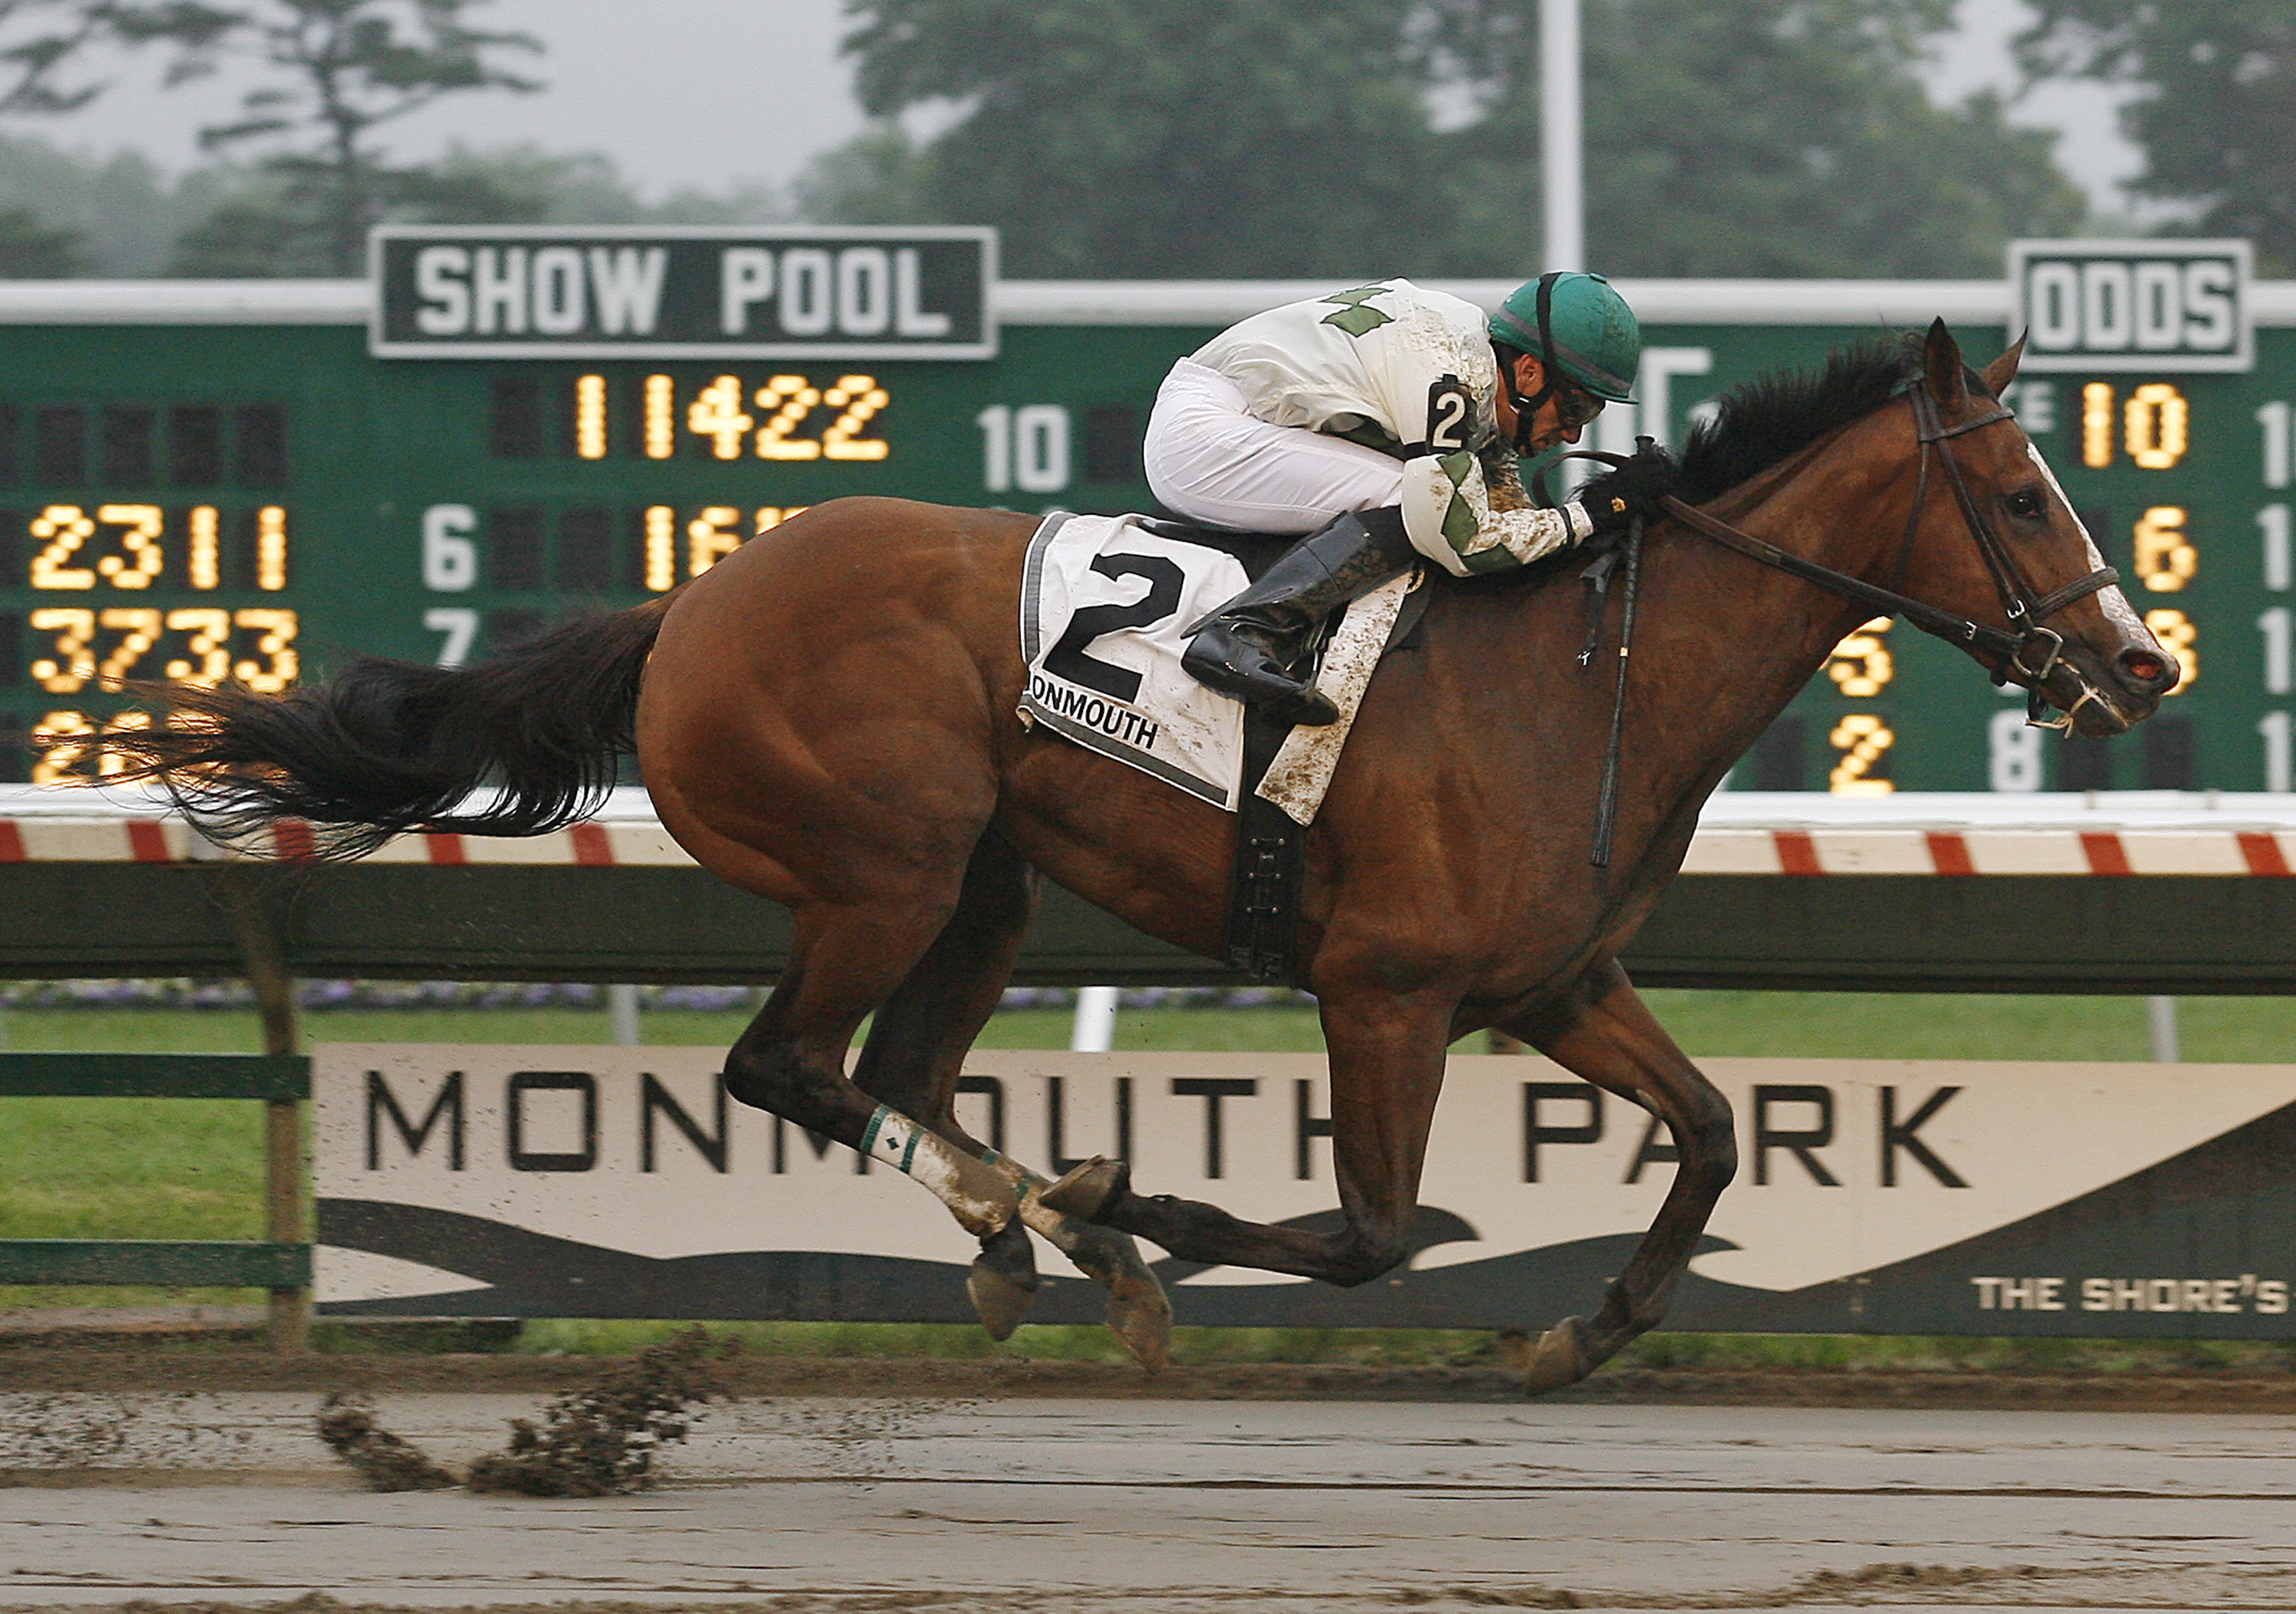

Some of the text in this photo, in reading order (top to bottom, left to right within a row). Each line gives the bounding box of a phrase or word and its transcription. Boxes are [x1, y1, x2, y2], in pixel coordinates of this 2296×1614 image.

[416, 246, 951, 337] SHOW POOL
[2032, 262, 2235, 352] ODDS
[576, 373, 889, 461] 11422
[977, 404, 1069, 492] 10
[1432, 392, 1466, 448] 2
[2082, 383, 2189, 469] 10
[30, 504, 287, 590] 2311
[422, 504, 476, 591] 6
[2134, 506, 2197, 592] 6
[30, 608, 299, 693] 3733
[424, 608, 478, 670] 7
[1042, 553, 1186, 704] 2
[1829, 714, 1895, 797] 2
[1990, 709, 2043, 791] 8
[1970, 1273, 2288, 1314] THE SHORE'S
